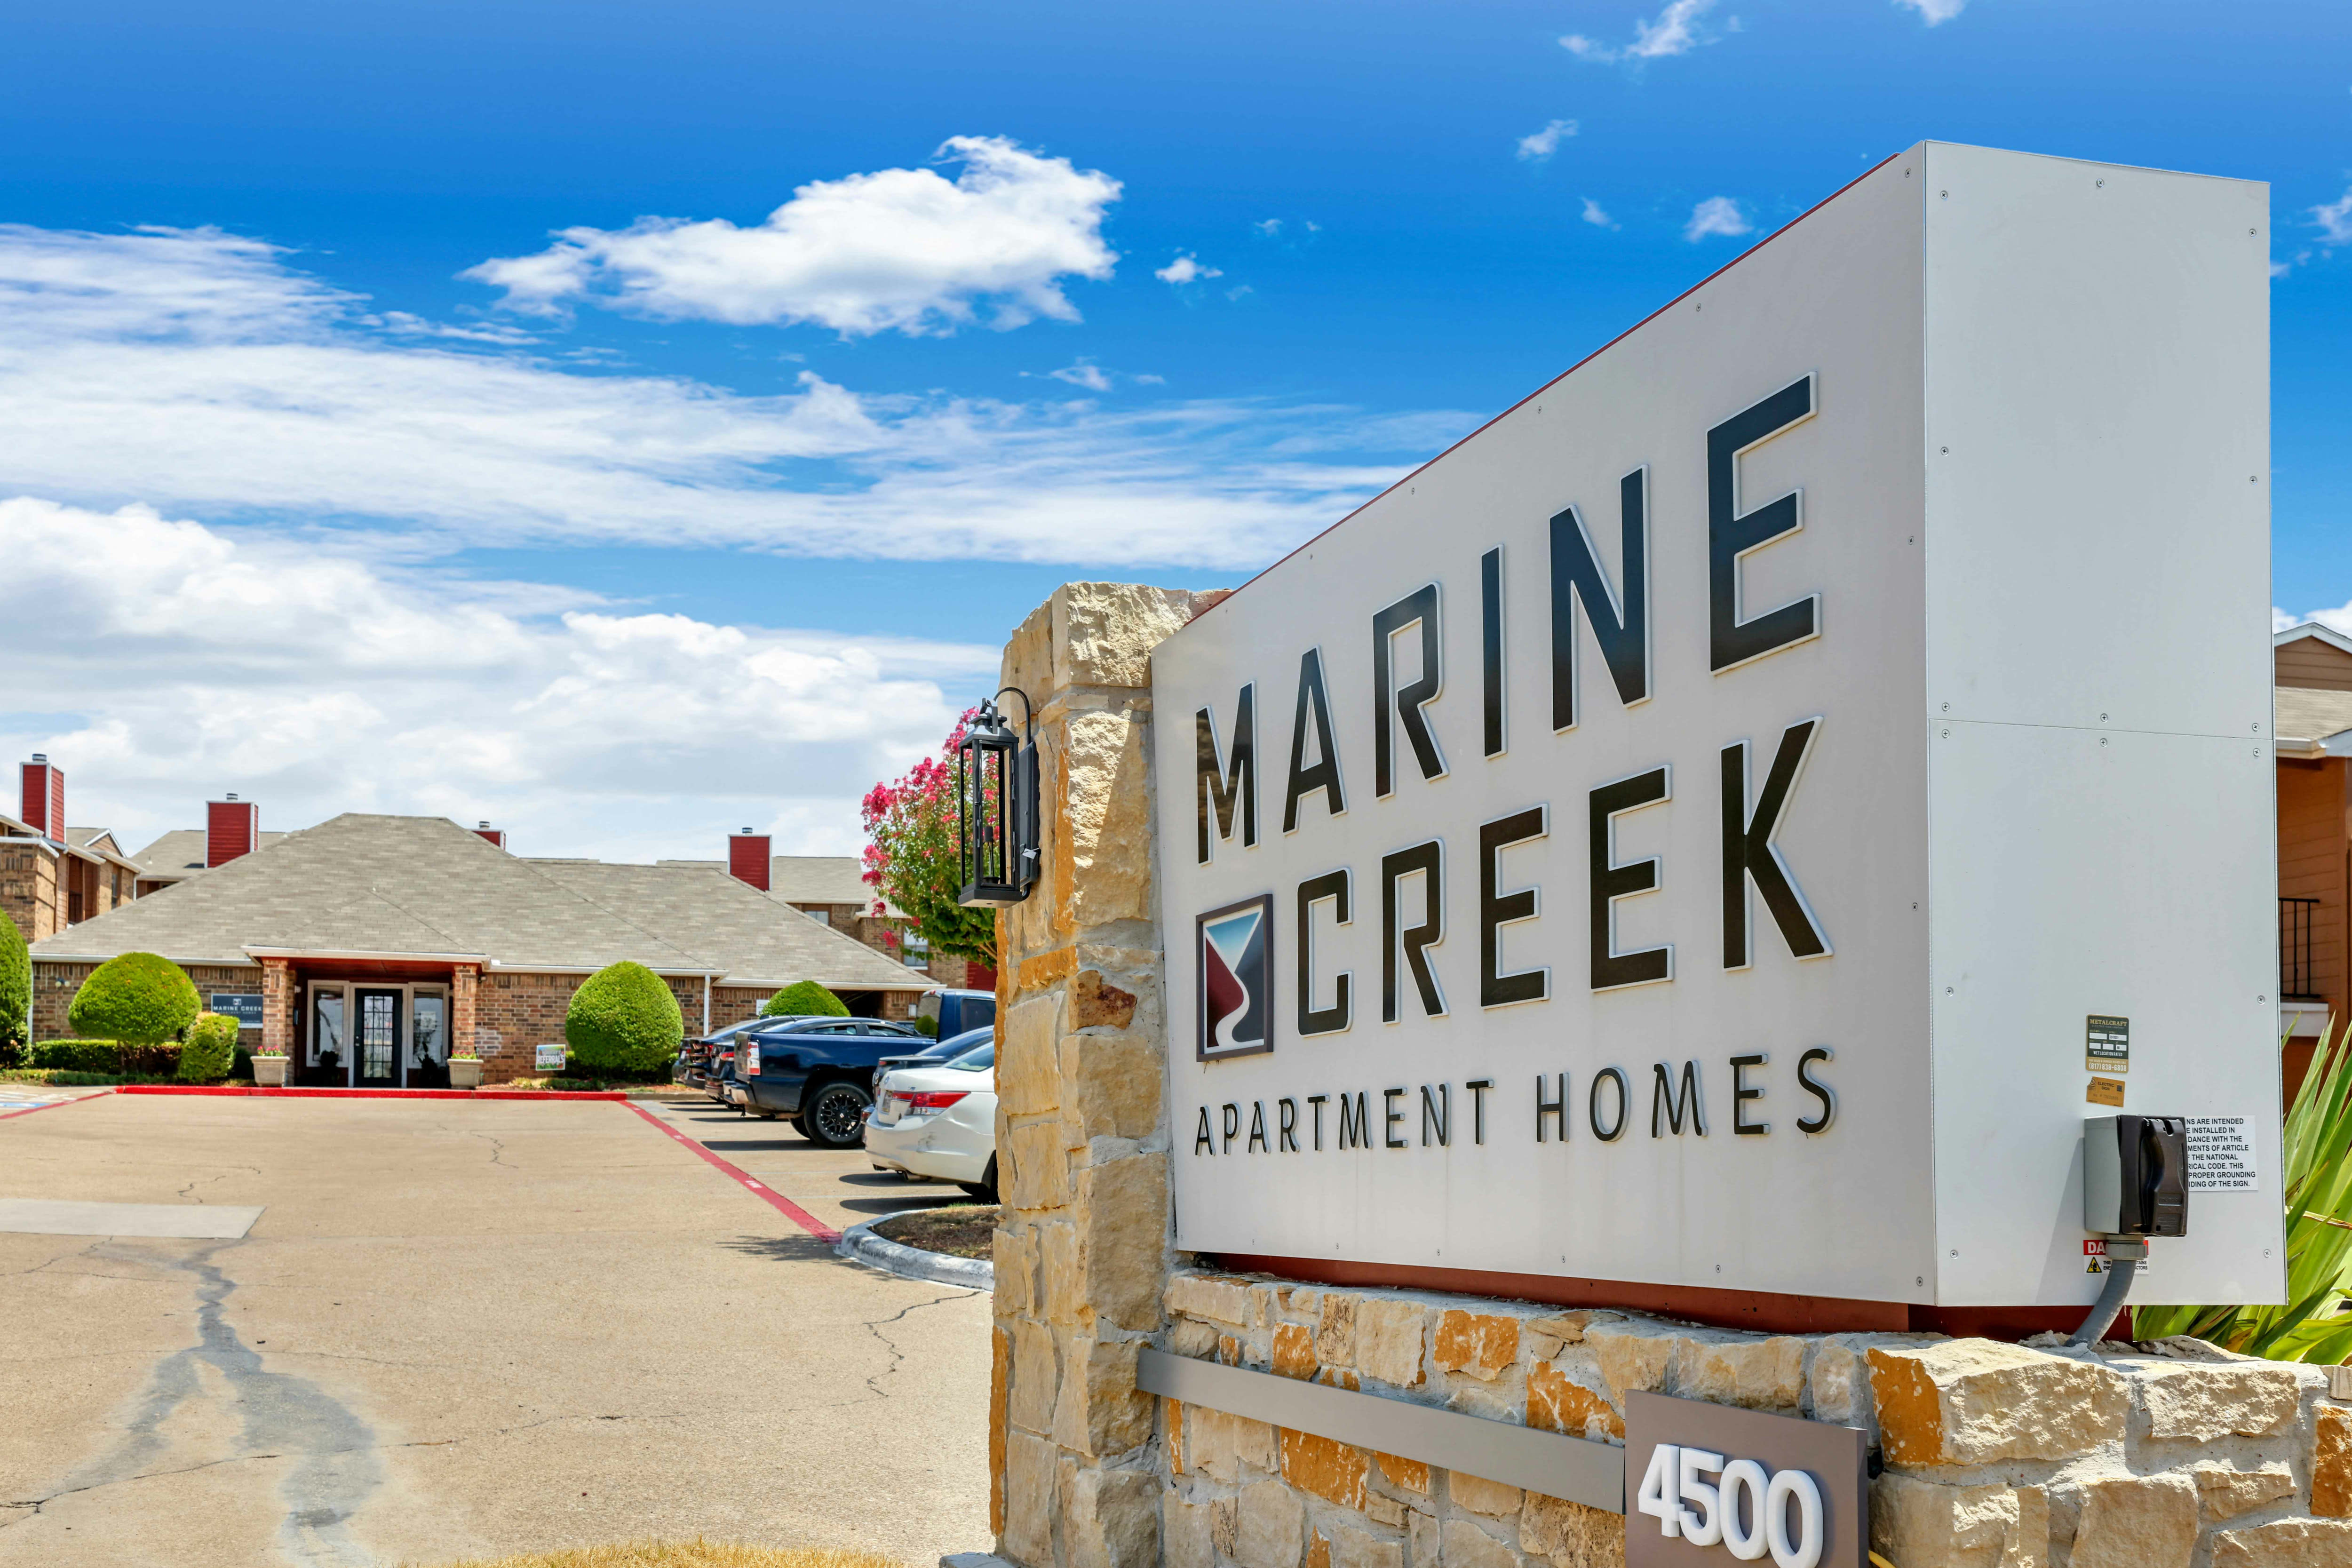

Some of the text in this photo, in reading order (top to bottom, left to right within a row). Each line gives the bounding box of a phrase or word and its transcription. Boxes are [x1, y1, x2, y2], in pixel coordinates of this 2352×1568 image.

[1195, 371, 1821, 867] MARINE
[1297, 715, 1834, 1037] CREEK
[1195, 1048, 1835, 1156] APARTMENT HOMES
[1638, 1444, 1823, 1568] 4500
